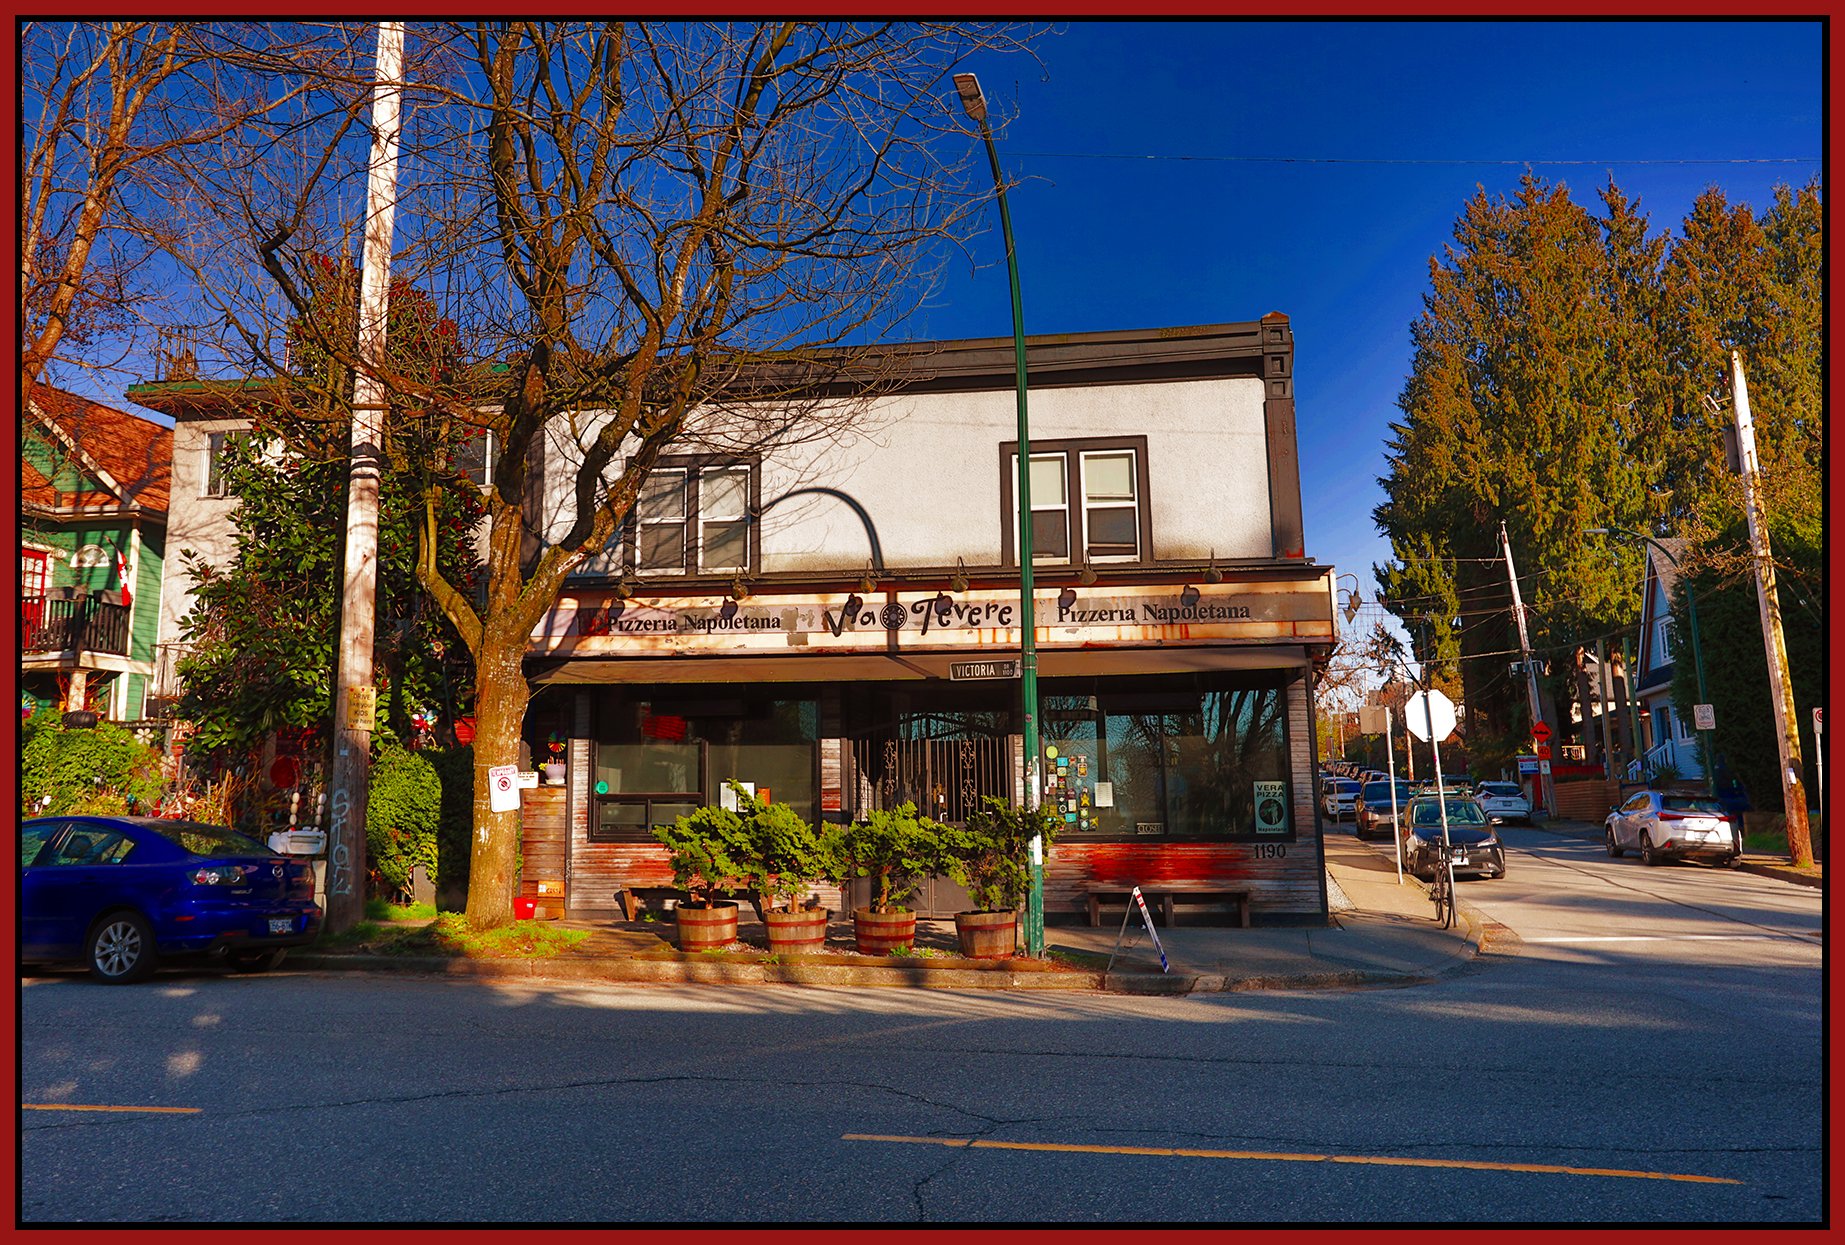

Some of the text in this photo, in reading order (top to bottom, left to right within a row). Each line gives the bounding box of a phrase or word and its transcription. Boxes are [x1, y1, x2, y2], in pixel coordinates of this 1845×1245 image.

[608, 613, 781, 634] Pizzeria Napoletana
[824, 597, 1013, 637] Via Tevere
[1057, 604, 1251, 624] Pizzeria Napoletana
[956, 664, 995, 677] VICTORIA
[1254, 844, 1287, 859] 1190
